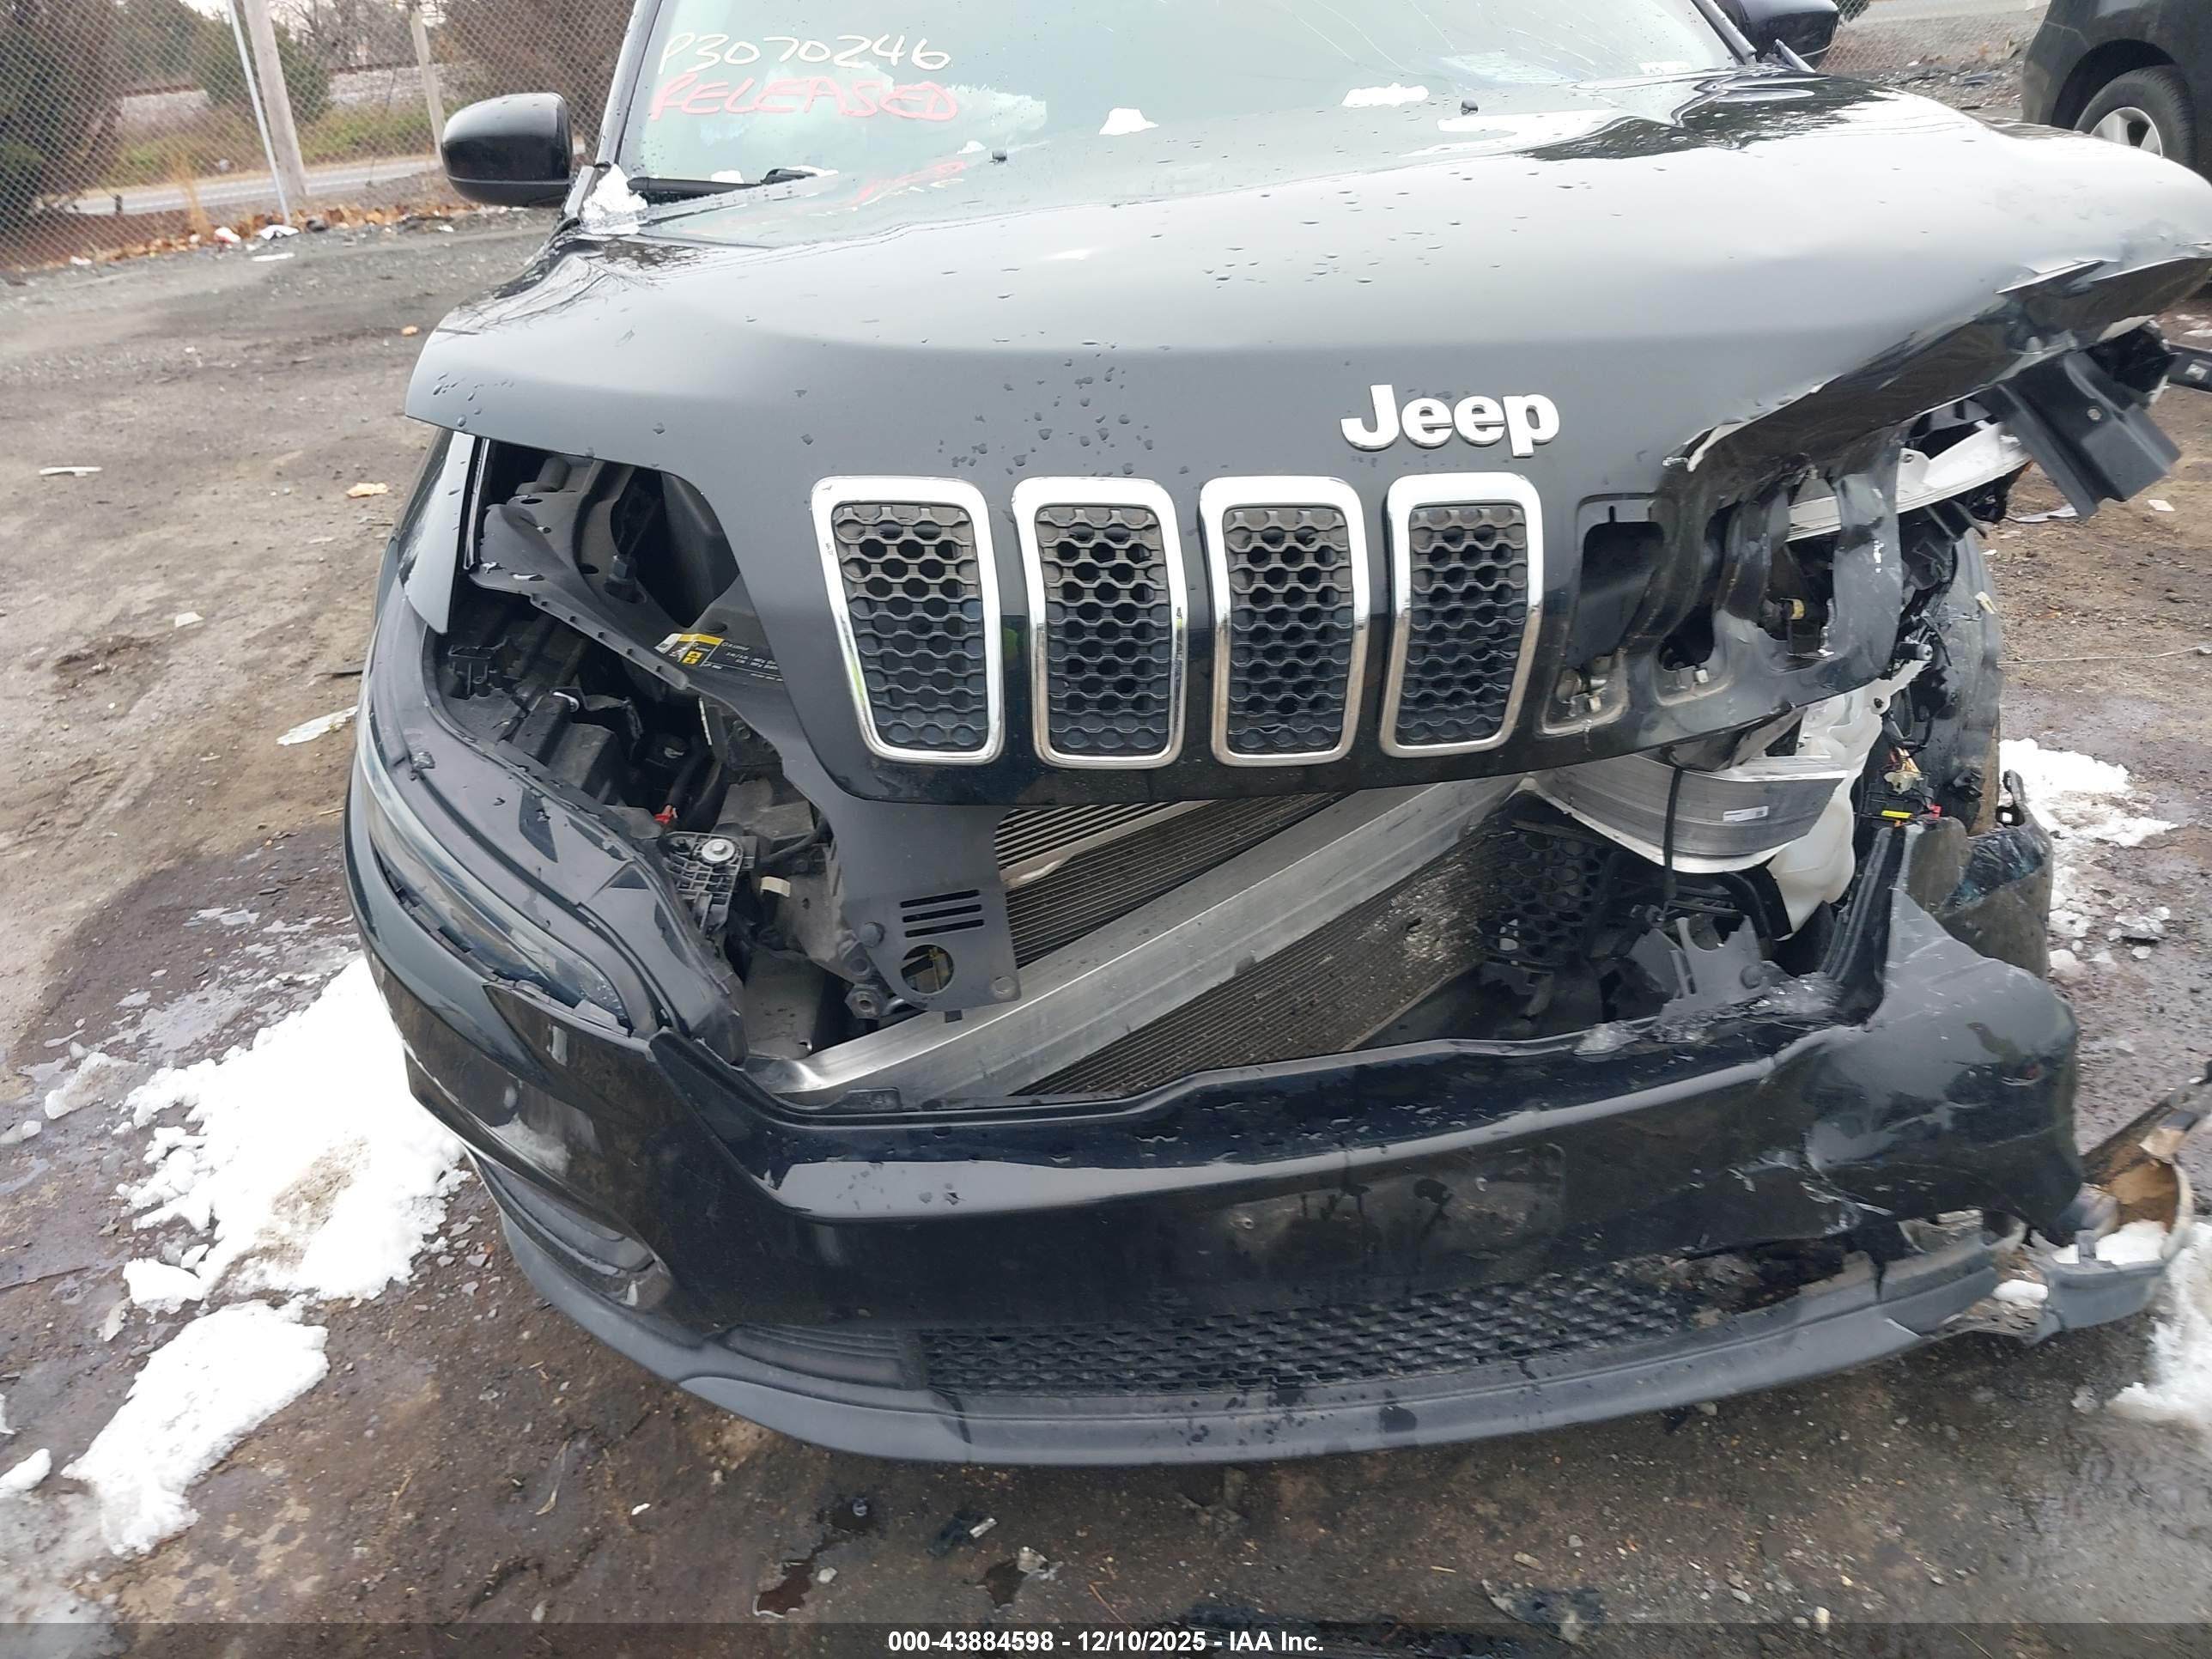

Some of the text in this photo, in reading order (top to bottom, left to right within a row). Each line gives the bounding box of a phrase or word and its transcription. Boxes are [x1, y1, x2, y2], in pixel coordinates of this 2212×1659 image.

[658, 32, 951, 75] P3070246
[650, 72, 958, 120] RELEASED
[1340, 384, 1560, 457] Jeep
